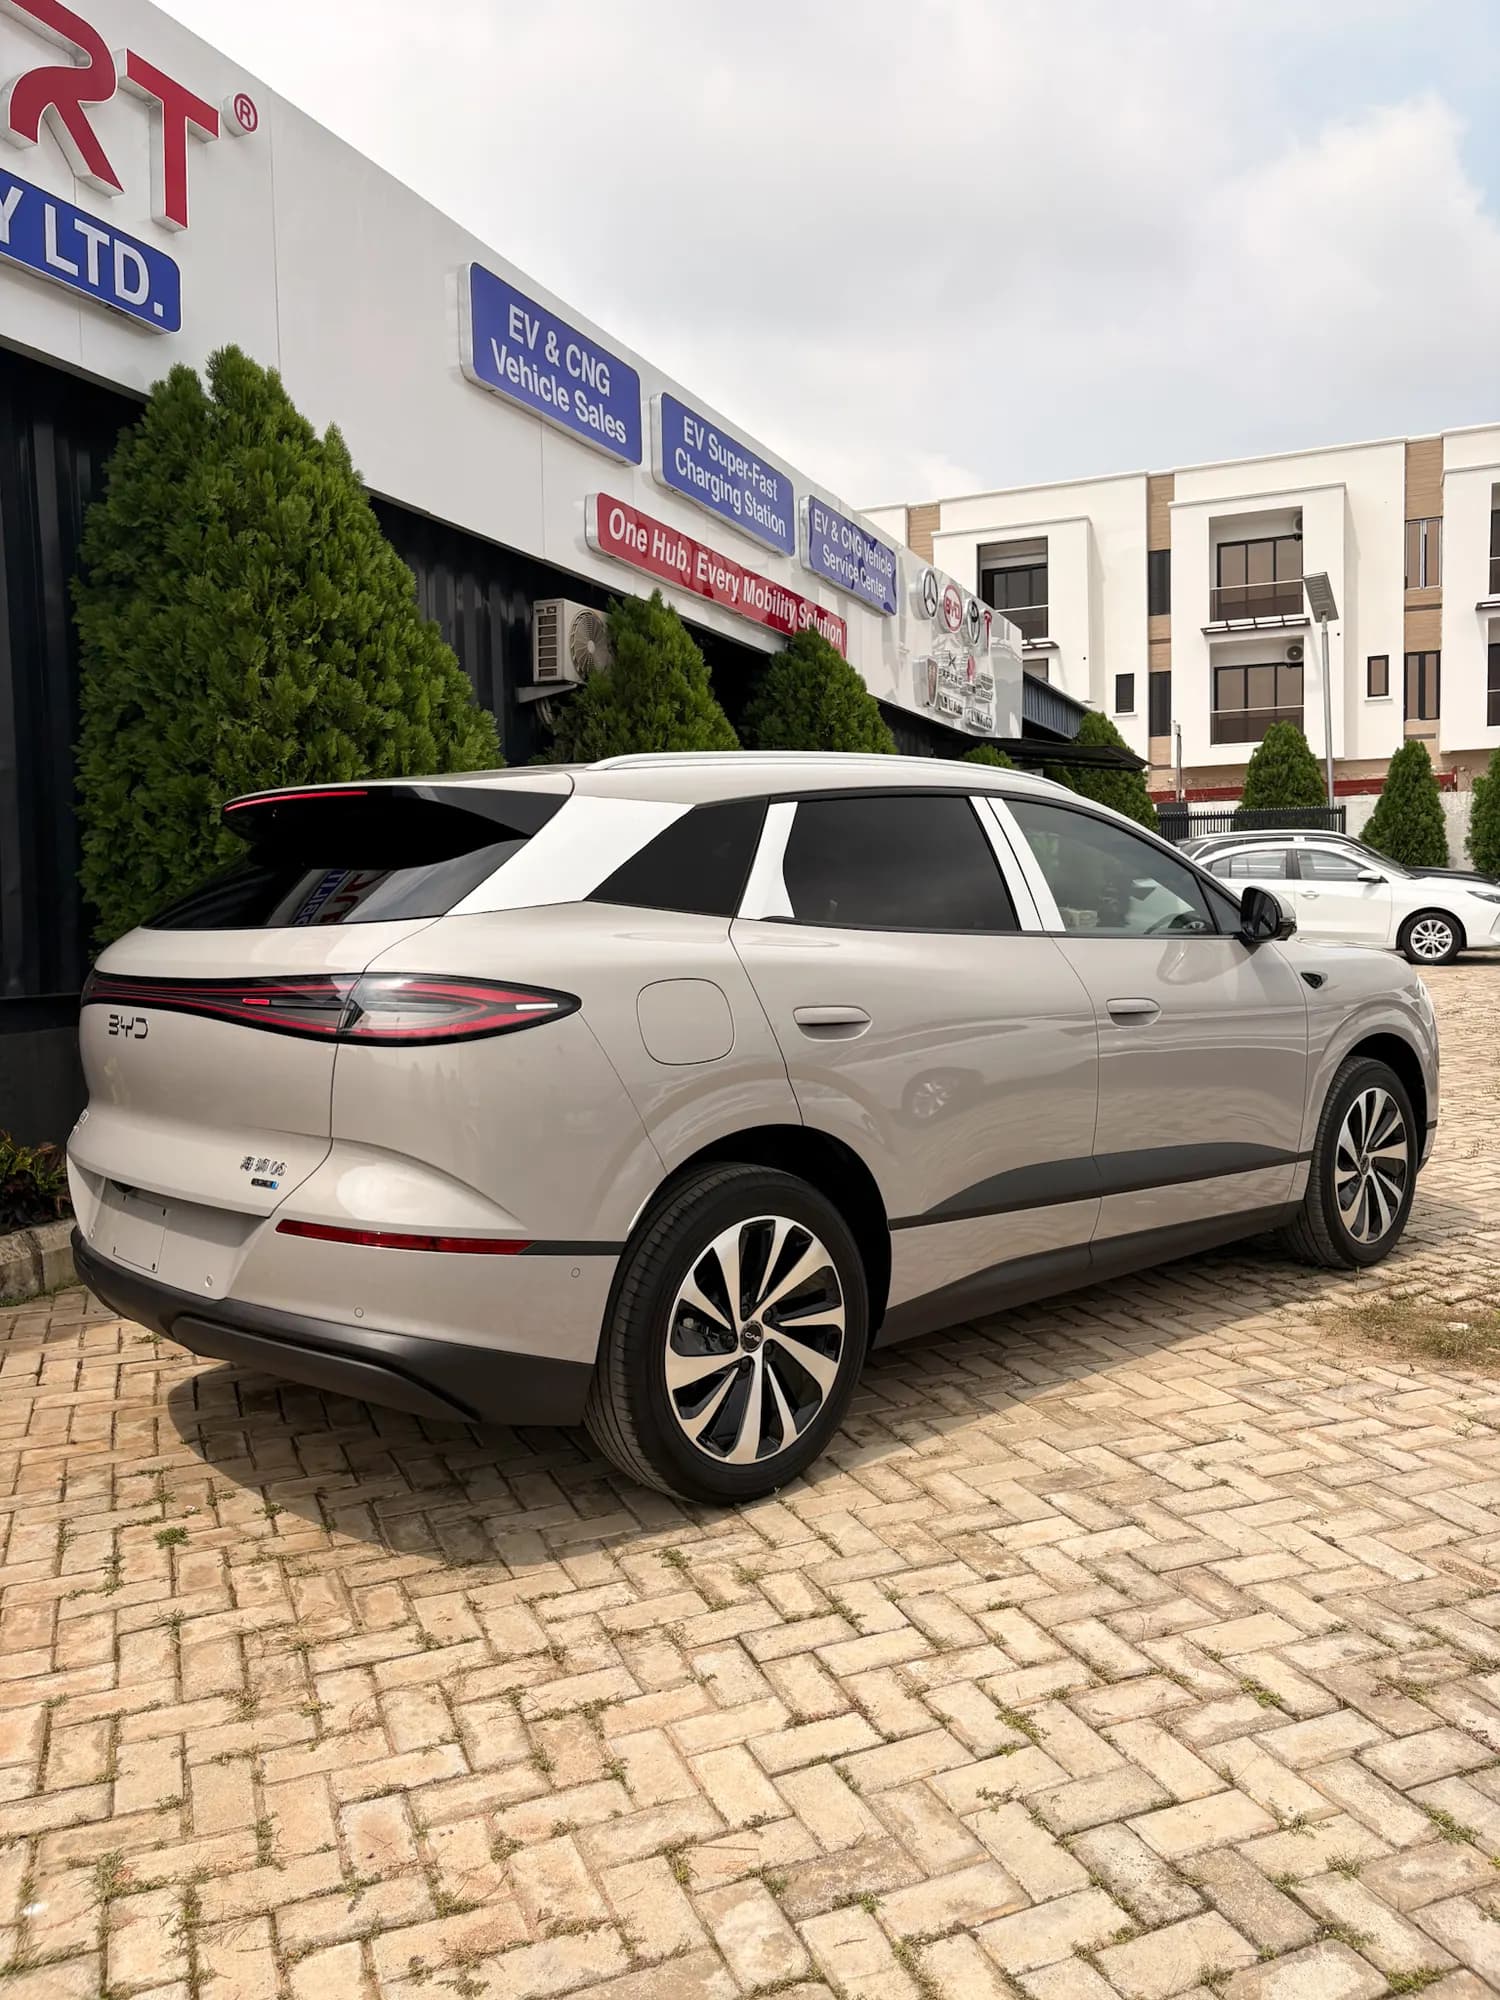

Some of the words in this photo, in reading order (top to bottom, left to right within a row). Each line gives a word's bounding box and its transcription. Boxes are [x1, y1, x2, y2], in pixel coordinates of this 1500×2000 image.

[44, 203, 164, 318] LTD.
[490, 337, 570, 412] Vehicle
[574, 389, 627, 444] Sales
[509, 303, 540, 350] EV
[545, 330, 560, 367] &
[566, 344, 610, 397] CNG
[675, 447, 742, 516] Charging
[744, 490, 787, 538] Station
[683, 415, 705, 451] EV
[708, 433, 779, 503] Super-Fast
[609, 508, 648, 552] One
[652, 529, 691, 574] Hub.
[697, 552, 740, 602] Every
[743, 576, 796, 629] Mobility
[814, 508, 828, 535] EV
[831, 521, 839, 543] &
[841, 526, 862, 558] CNG
[864, 541, 892, 578] Vehicle
[822, 543, 859, 582] Service
[860, 567, 886, 600] Center
[108, 1014, 148, 1039] BYD
